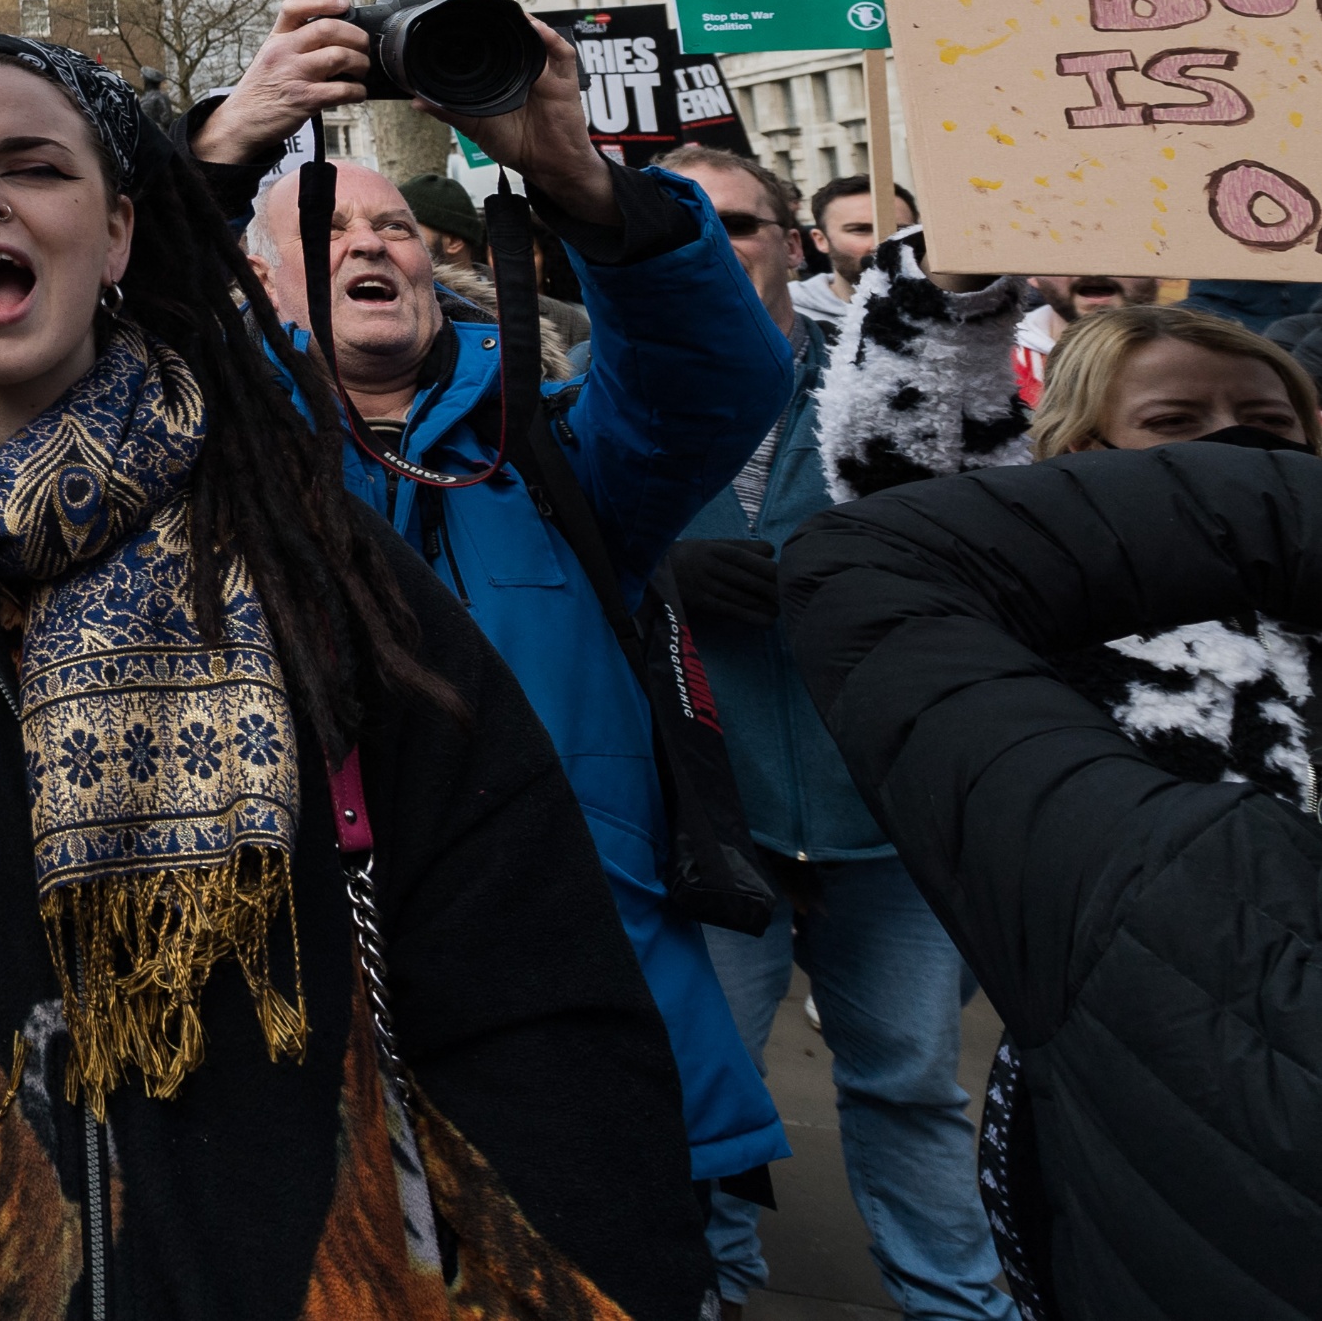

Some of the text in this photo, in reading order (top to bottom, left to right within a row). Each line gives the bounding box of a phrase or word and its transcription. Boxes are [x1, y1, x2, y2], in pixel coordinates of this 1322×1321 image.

[702, 11, 775, 23] Stop the War
[703, 22, 753, 32] Coalition
[576, 36, 659, 74] RIES
[580, 72, 661, 134] UT
[676, 85, 733, 123] ERN
[1056, 46, 1255, 129] IS
[383, 451, 457, 483] Canon
